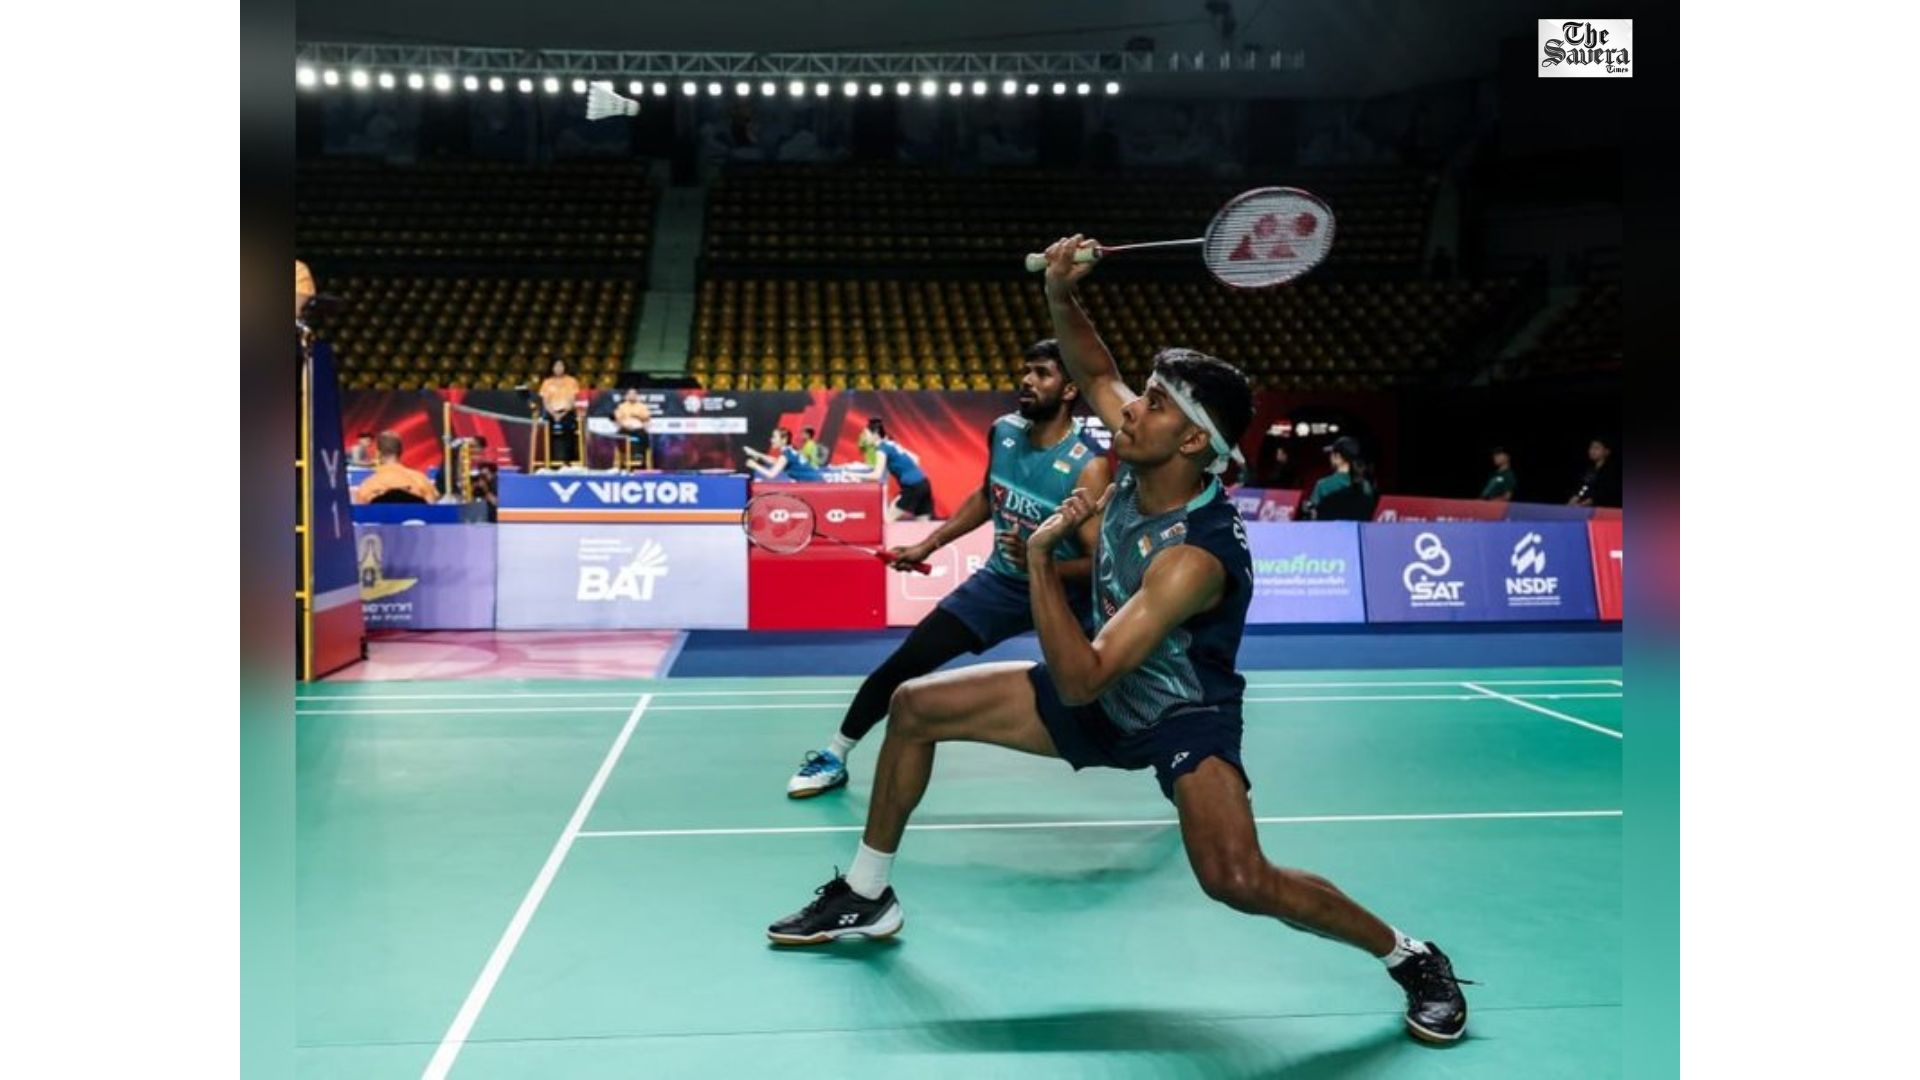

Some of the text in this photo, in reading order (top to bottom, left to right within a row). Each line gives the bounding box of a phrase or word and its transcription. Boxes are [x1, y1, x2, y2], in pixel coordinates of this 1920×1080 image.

[587, 481, 699, 503] VICTOR
[1005, 489, 1042, 521] DBS
[1253, 553, 1346, 574] พลศึกษา
[577, 566, 669, 600] BAT
[1410, 581, 1464, 600] SAT
[1506, 577, 1558, 595] NSDF
